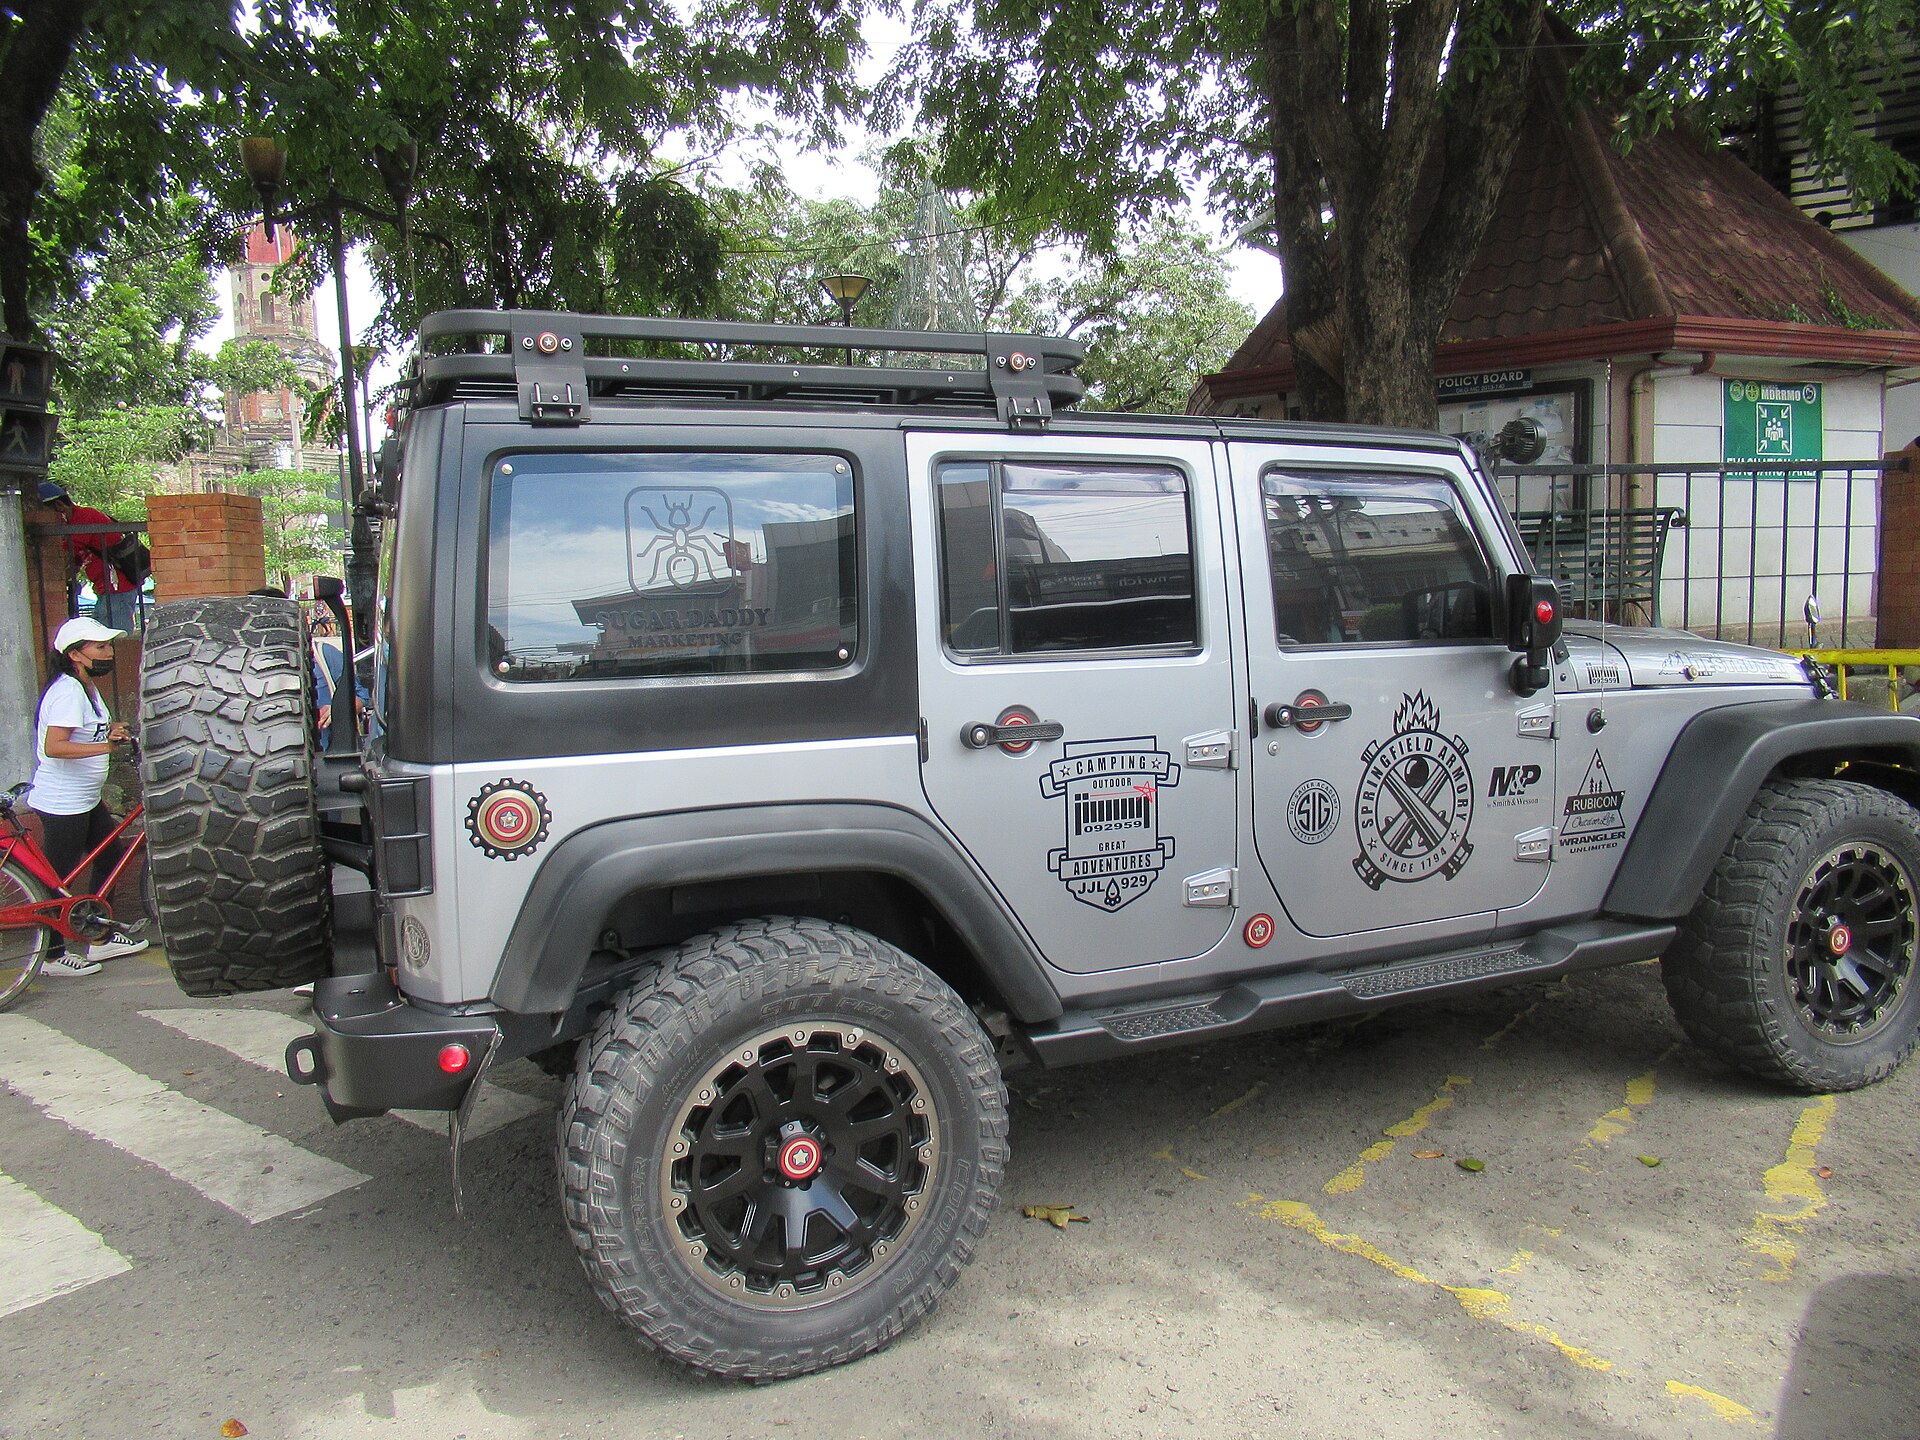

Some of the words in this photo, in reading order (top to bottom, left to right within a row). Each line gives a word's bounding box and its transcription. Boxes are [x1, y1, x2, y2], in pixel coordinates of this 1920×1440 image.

[1439, 376, 1479, 388] POLICY
[1483, 371, 1524, 384] BOARD
[595, 609, 682, 630] SUGAR
[686, 607, 770, 628] DADDY
[627, 631, 742, 648] MARKETING
[1076, 755, 1146, 775] CAMPING
[1092, 777, 1132, 789] OUTDOOR
[1361, 736, 1433, 829] SPRINGFIELD
[1437, 744, 1469, 821] ARMORY
[1488, 764, 1541, 797] M&P
[1297, 792, 1331, 832] SIG
[1572, 796, 1617, 811] RUBICON
[1083, 820, 1143, 833] 092959
[1098, 840, 1126, 851] GREAT
[1559, 831, 1626, 847] WRANGLER
[1569, 842, 1618, 854] UNLIMITED
[1073, 853, 1151, 875] ADVENTURES
[1379, 852, 1414, 873] SINCE
[1421, 847, 1448, 870] 1794
[1078, 881, 1105, 894] JJL
[1121, 875, 1148, 889] 929
[760, 993, 832, 1018] STT
[836, 997, 895, 1020] PRO
[894, 1158, 971, 1295] COOPER
[631, 1156, 727, 1330] DISCOVERER
